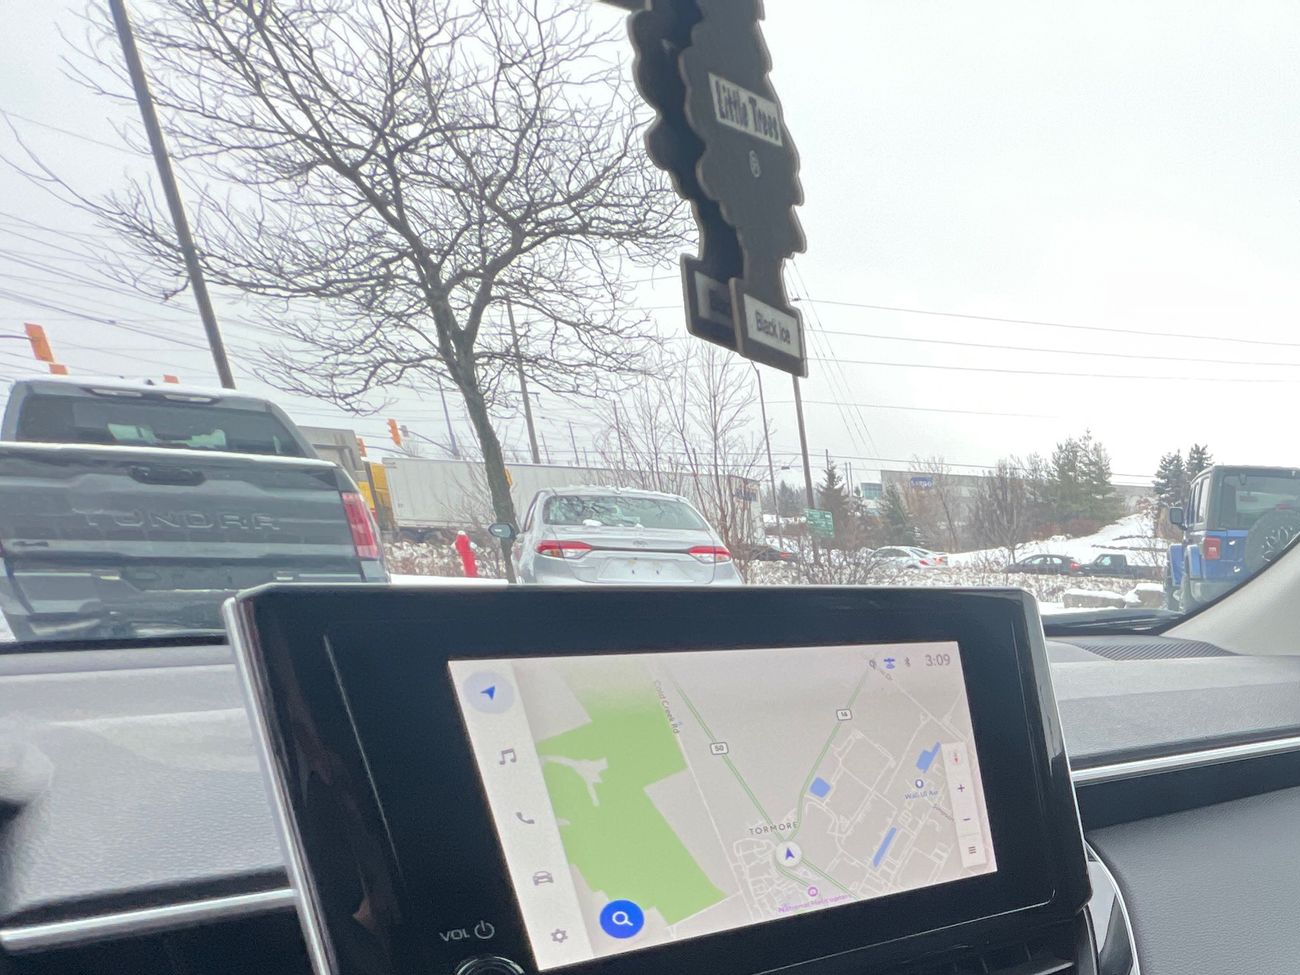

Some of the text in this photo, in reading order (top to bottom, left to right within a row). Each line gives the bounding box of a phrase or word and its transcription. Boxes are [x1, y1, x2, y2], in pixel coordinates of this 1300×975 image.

[715, 79, 779, 141] Little Trees
[755, 310, 791, 345] Black Ice
[73, 508, 280, 531] TUNDRA
[924, 654, 951, 667] 3:09
[671, 723, 680, 734] Rd
[714, 744, 725, 752] 50
[749, 822, 798, 835] TORMORE
[439, 928, 470, 941] VOL
